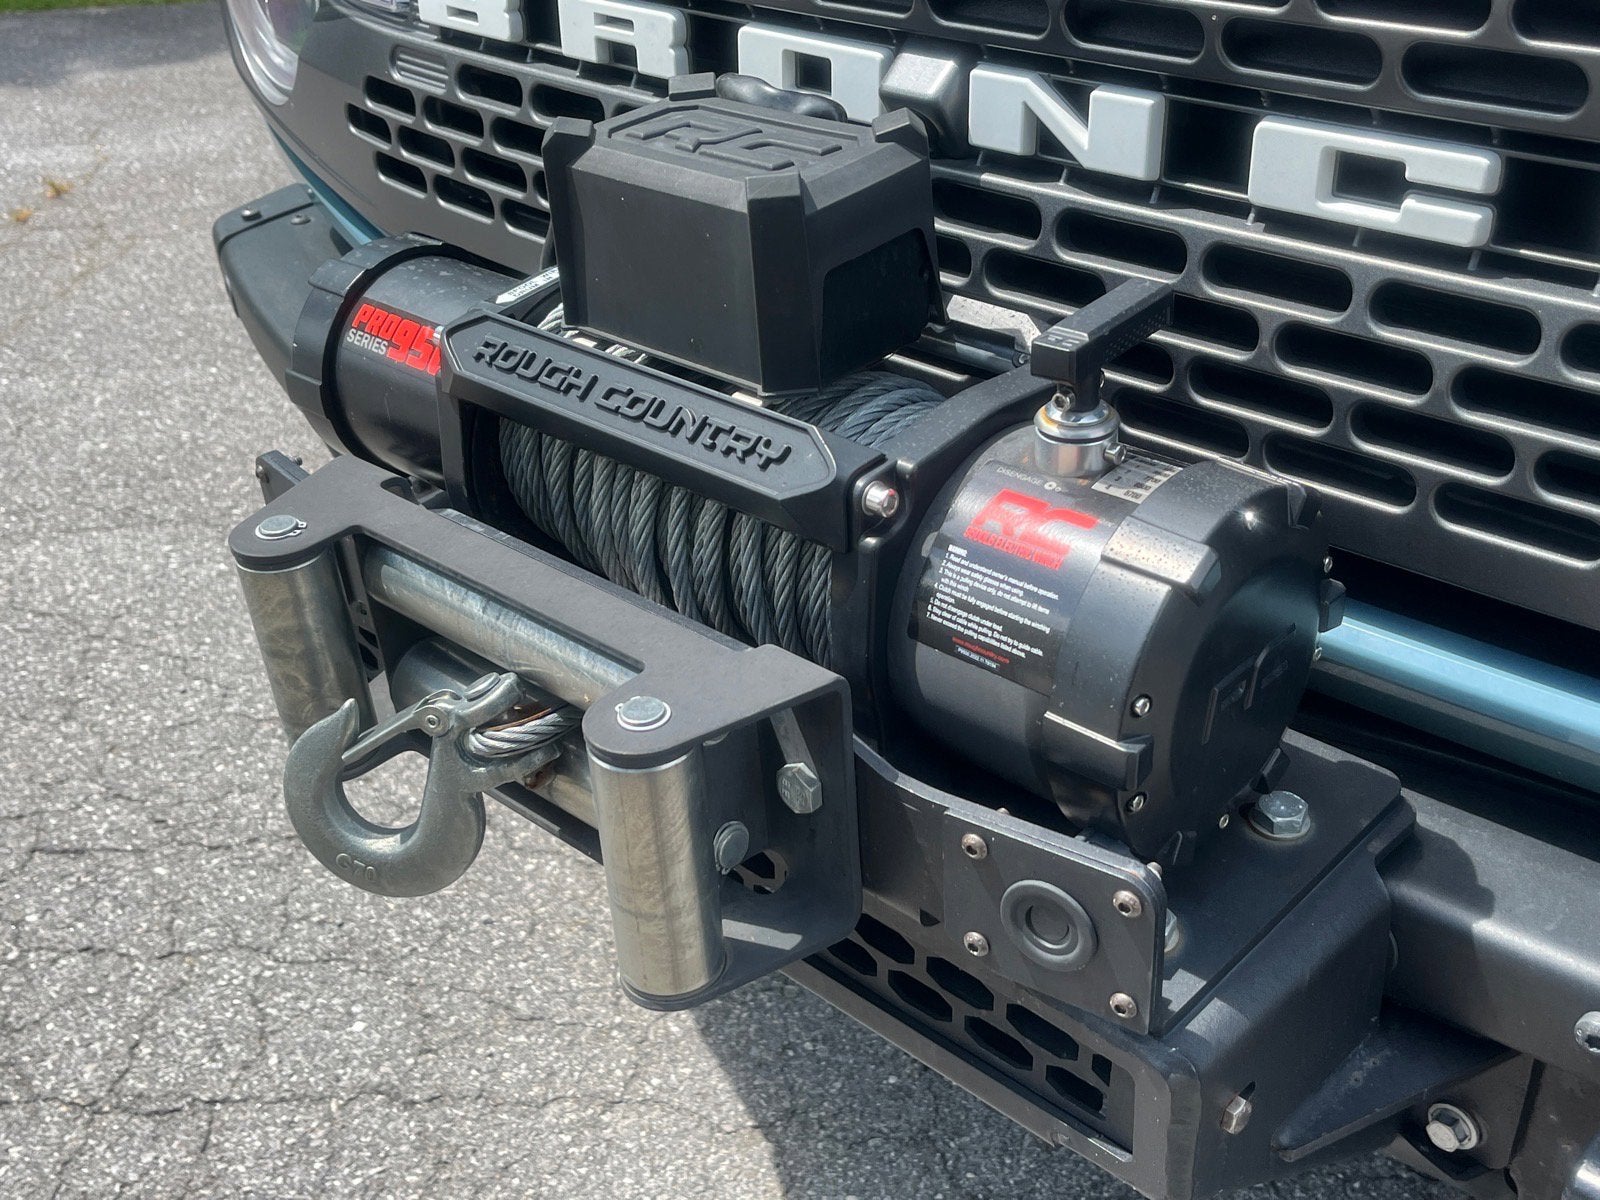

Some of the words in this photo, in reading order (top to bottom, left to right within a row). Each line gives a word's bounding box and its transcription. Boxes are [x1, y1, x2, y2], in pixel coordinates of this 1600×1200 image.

[346, 329, 388, 356] SERIES
[472, 335, 599, 402] ROUGH
[594, 382, 792, 471] COUNTRY
[996, 467, 1043, 486] DISENGAGE
[335, 852, 378, 883] G70
